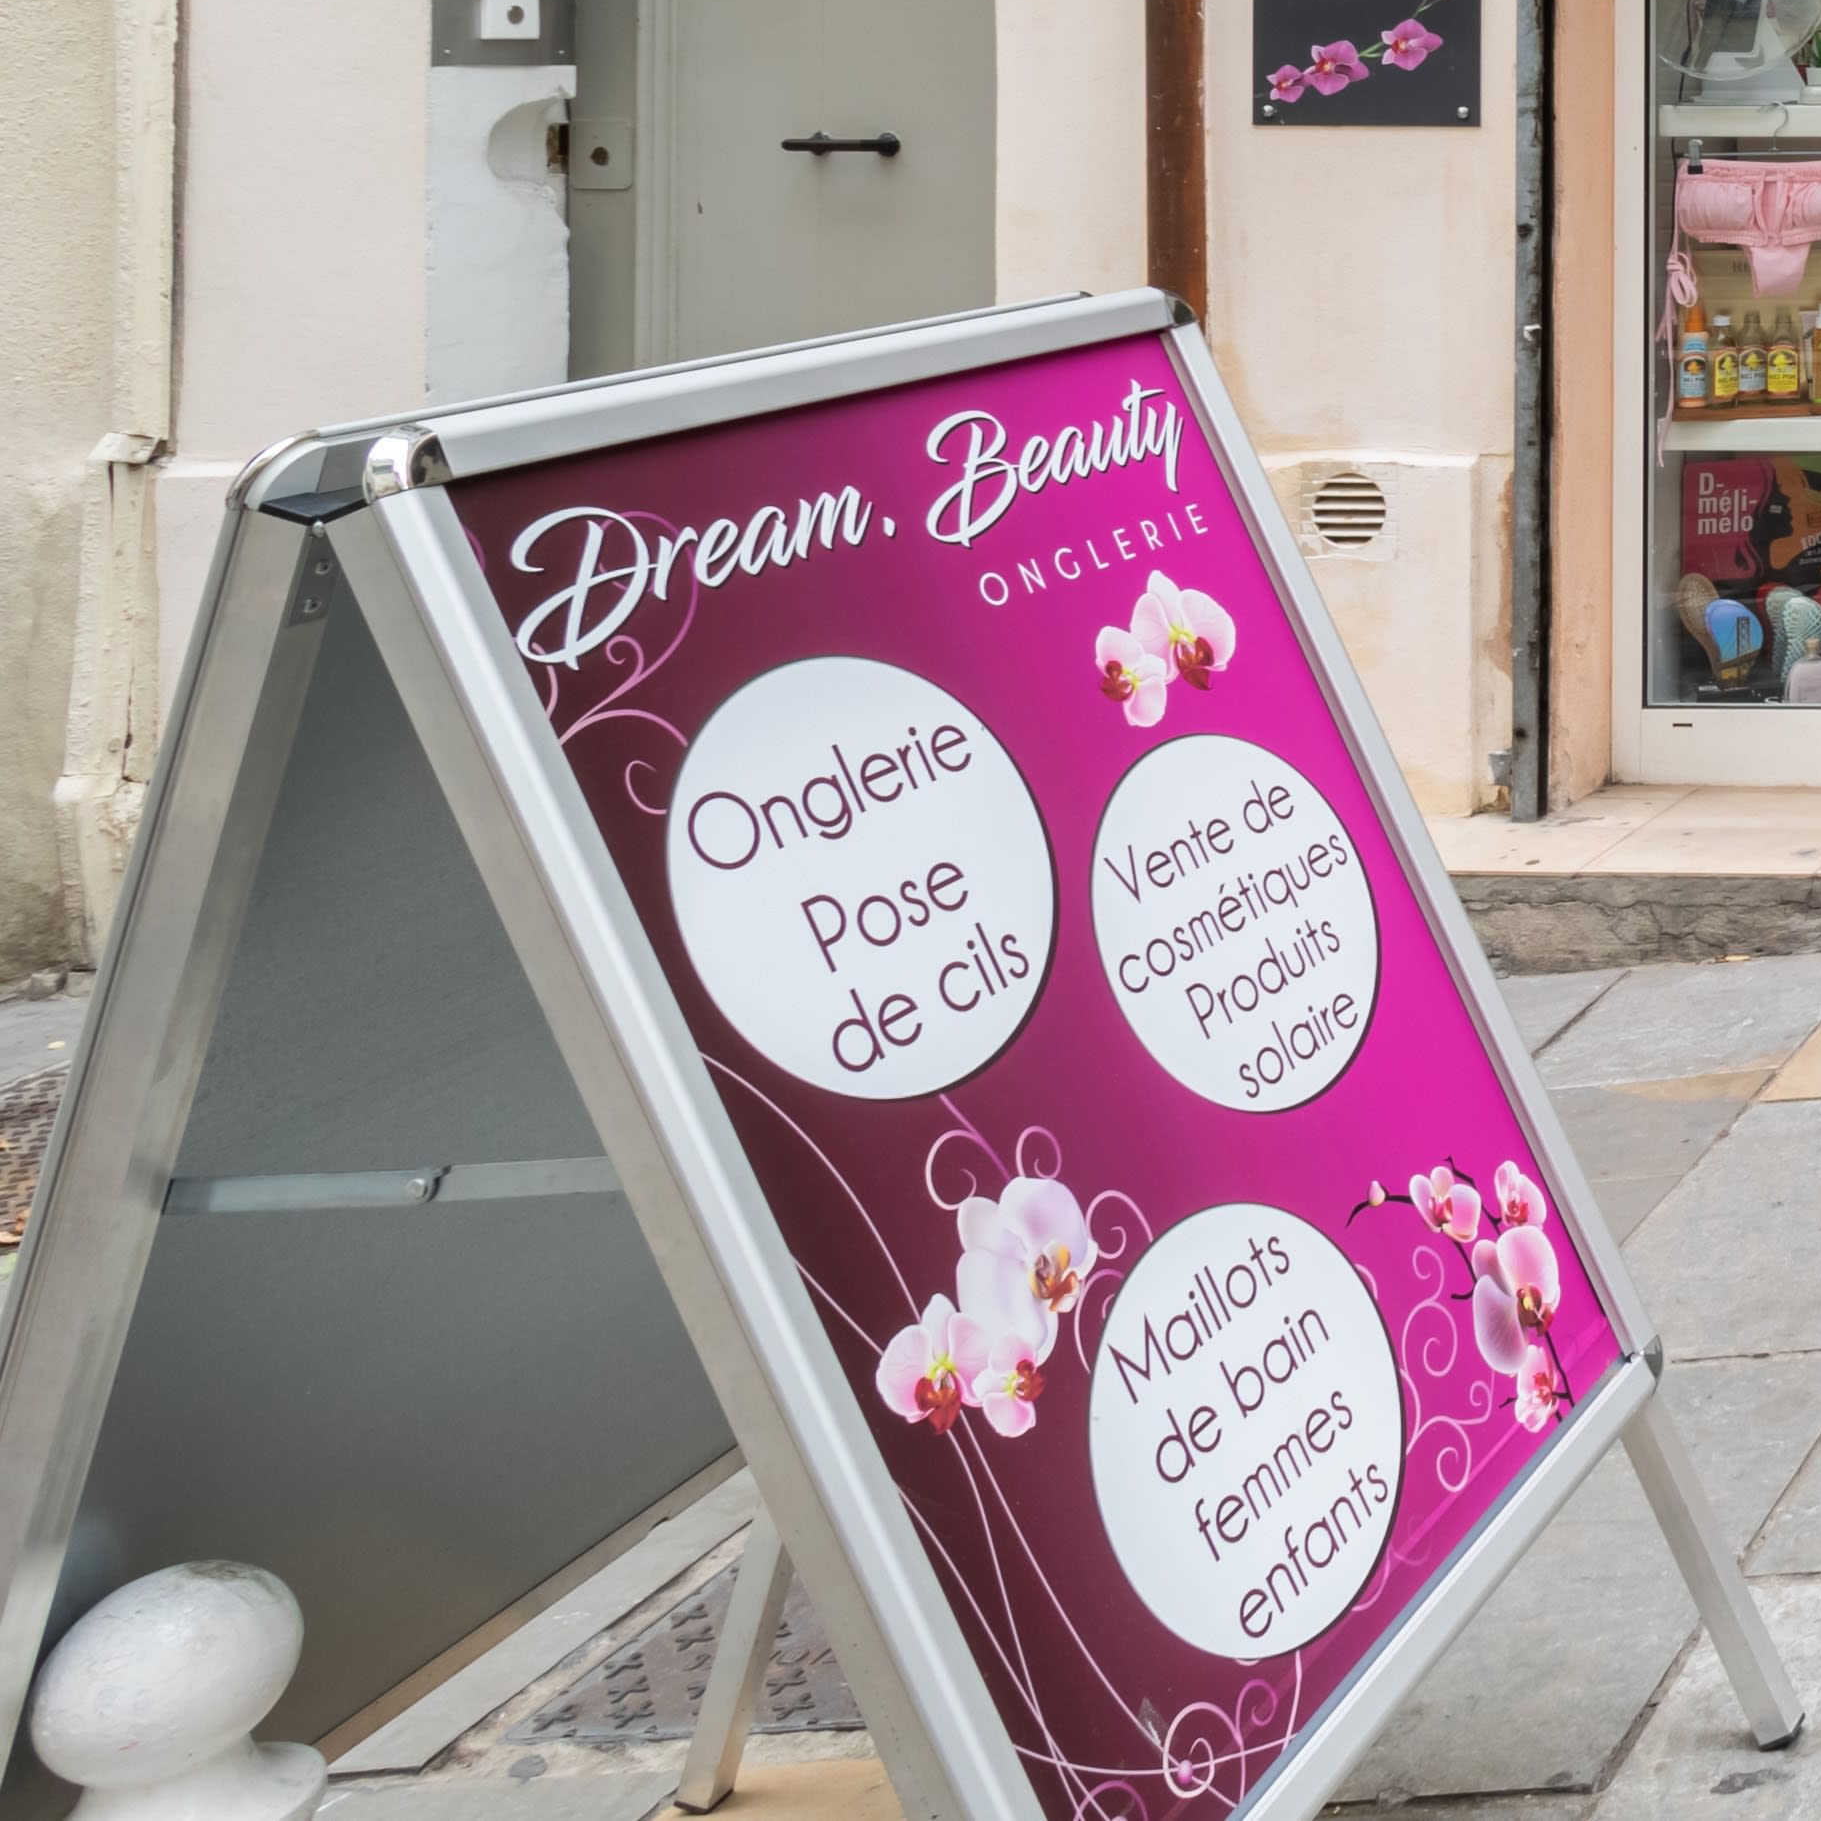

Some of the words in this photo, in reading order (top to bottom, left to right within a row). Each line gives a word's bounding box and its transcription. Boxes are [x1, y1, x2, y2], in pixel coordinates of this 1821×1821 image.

[925, 379, 1184, 547] Beauty
[1697, 489, 1758, 515] méli-
[1697, 508, 1754, 535] mélo
[1699, 472, 1725, 496] D-
[979, 503, 1209, 607] ONGLERIE
[687, 723, 972, 870] Onglerie
[1103, 814, 1234, 903] Vente
[1241, 779, 1295, 830] de
[800, 861, 969, 973] Pose
[1119, 828, 1350, 996] cosmétiques
[1186, 915, 1342, 1039] Produits
[830, 988, 924, 1073] de
[938, 922, 1031, 1012] cils
[1237, 990, 1359, 1100] solaire
[1107, 1230, 1292, 1405] Maillots
[1154, 1403, 1223, 1484] de
[1220, 1307, 1330, 1421] bain
[1194, 1385, 1354, 1562] femmes
[1238, 1459, 1389, 1638] enfants
